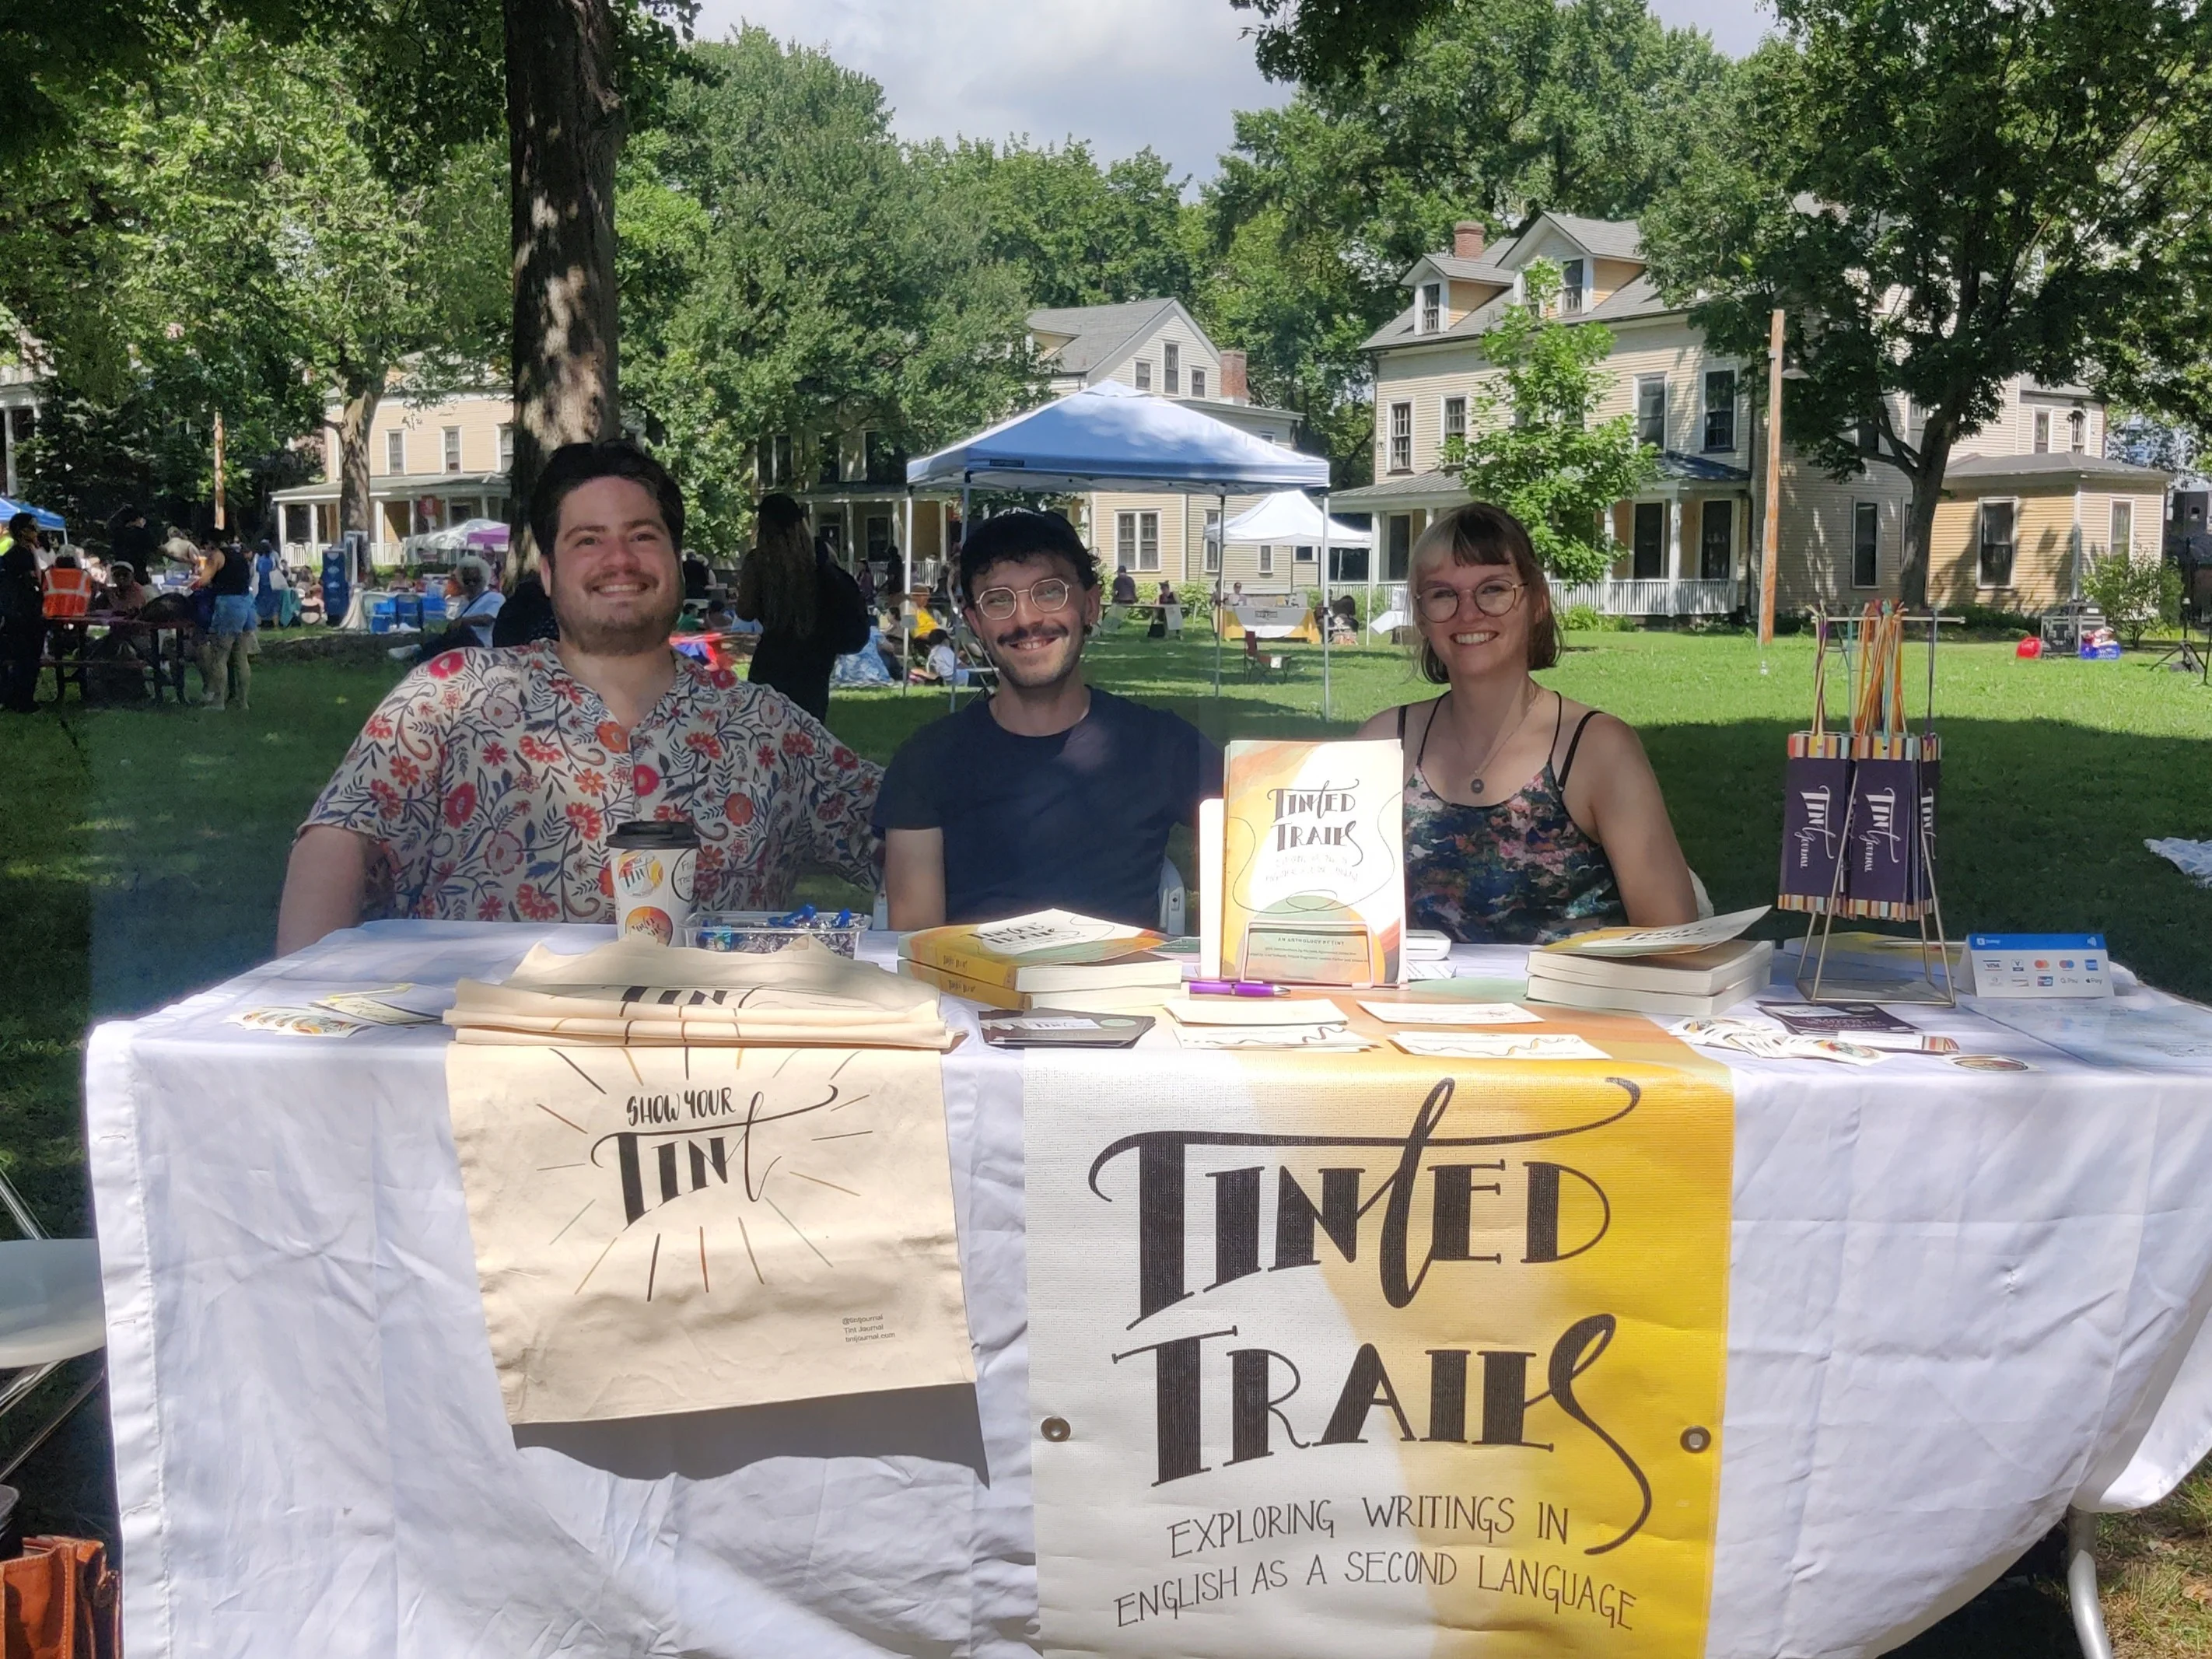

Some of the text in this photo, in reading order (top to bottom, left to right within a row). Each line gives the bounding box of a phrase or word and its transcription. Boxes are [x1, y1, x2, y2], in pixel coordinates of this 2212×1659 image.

[626, 1087, 736, 1126] SHOW YOUR
[1088, 1078, 1641, 1331] TINTED
[843, 1324, 884, 1335] Tint Journal
[1112, 1314, 1652, 1556] TRAILS
[1167, 1494, 1570, 1559] EXPLORING WRITINGS IN
[1112, 1550, 1637, 1632] ENGLISH AS A SECOND LANGUAGE
